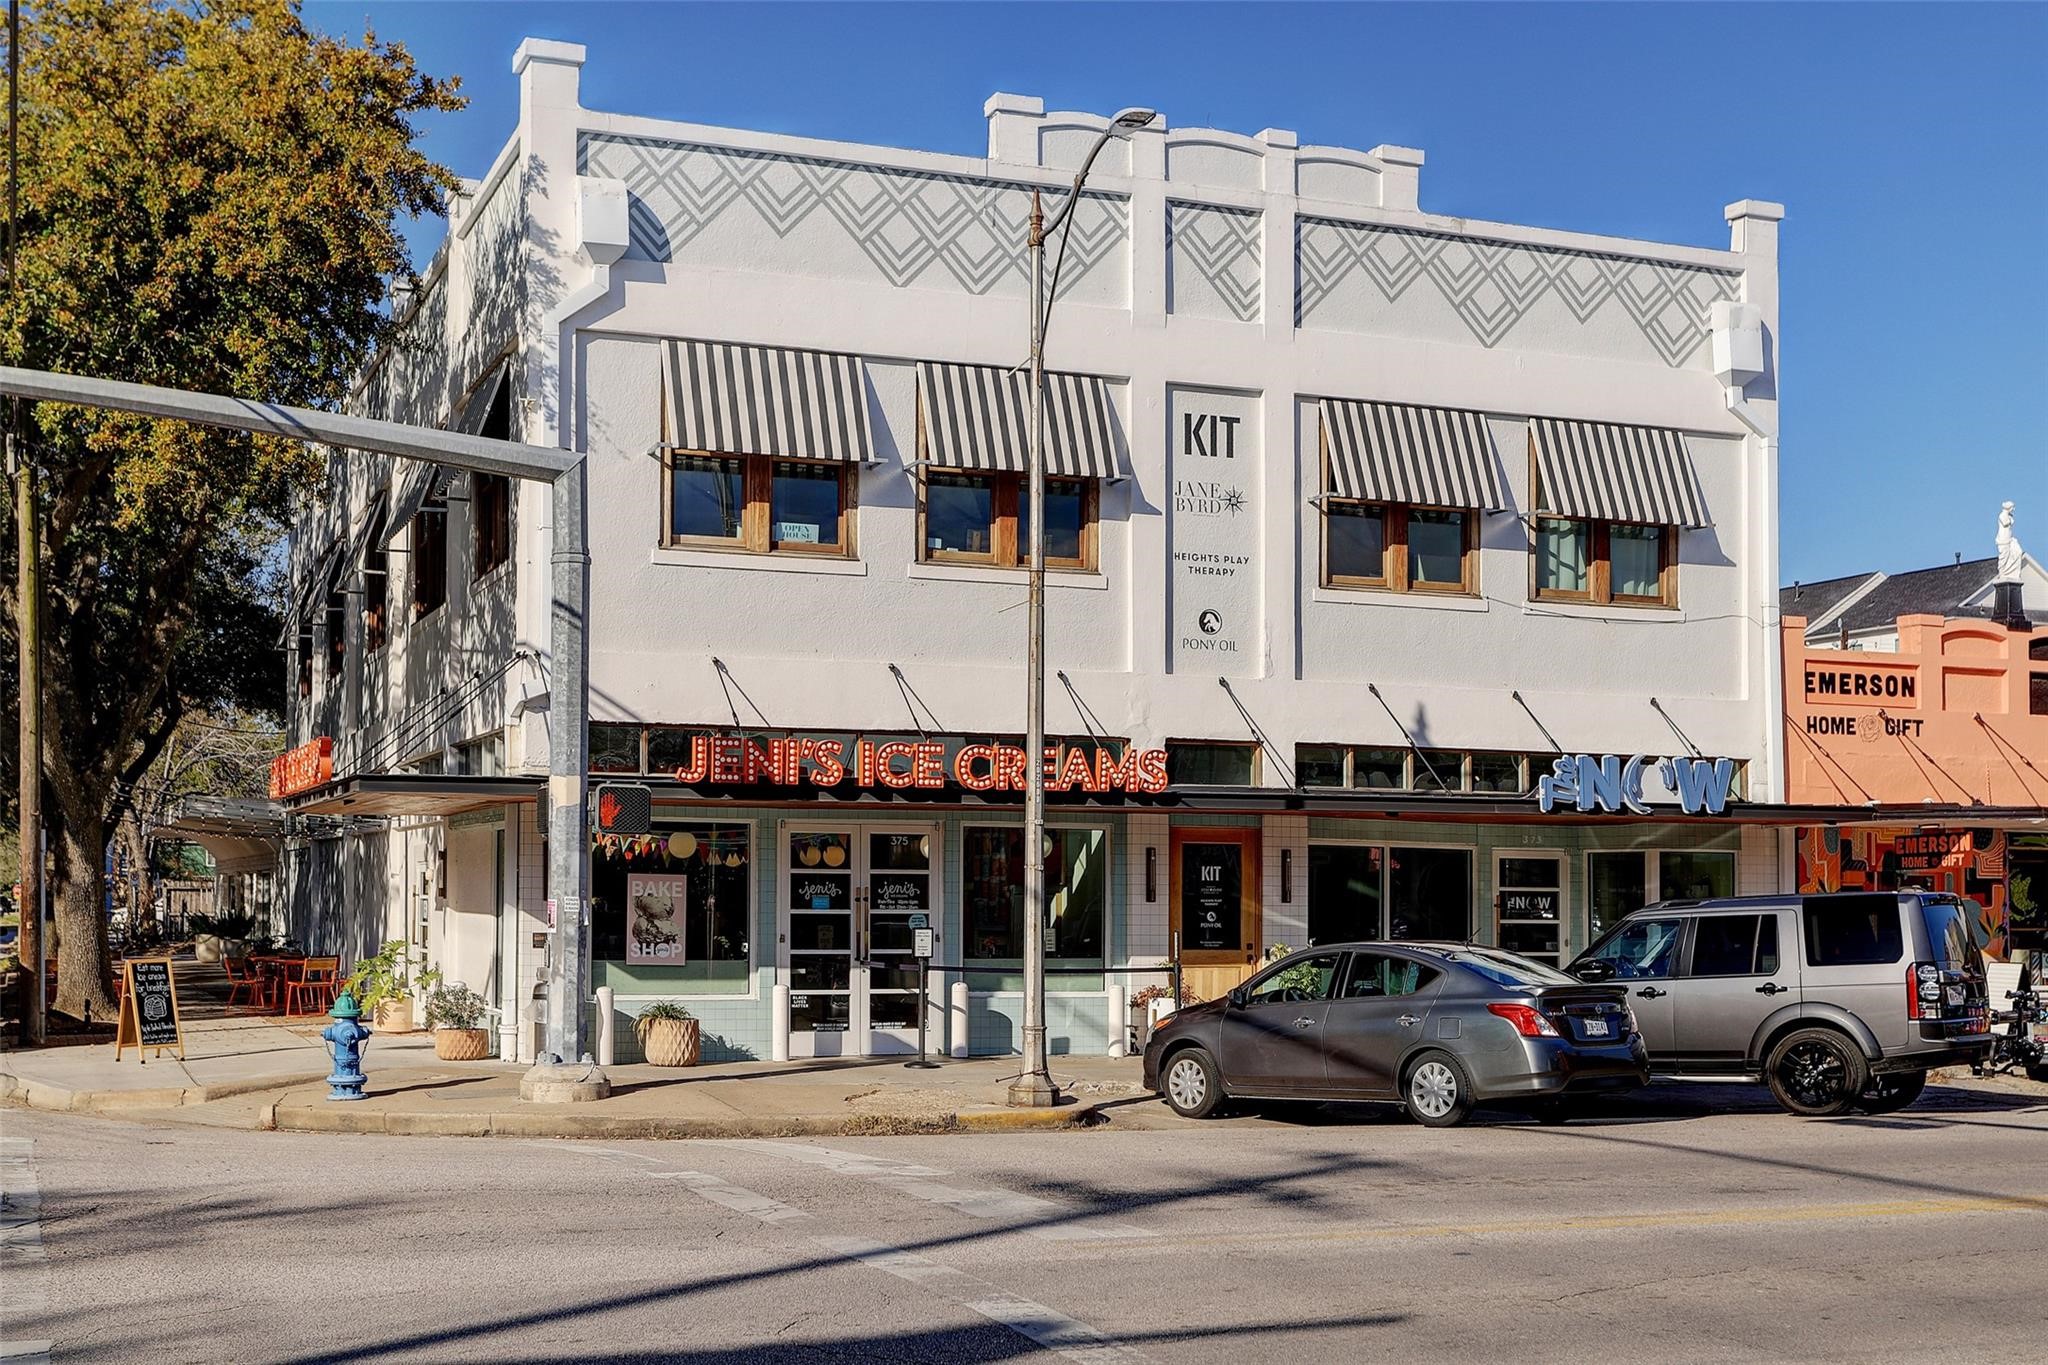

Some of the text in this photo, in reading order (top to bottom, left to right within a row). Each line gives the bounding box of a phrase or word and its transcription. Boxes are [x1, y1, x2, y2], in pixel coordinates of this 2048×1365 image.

[1184, 412, 1241, 459] KIT
[1175, 480, 1221, 499] JANE
[1176, 497, 1222, 513] BYRD
[784, 524, 810, 532] OPEN
[1174, 551, 1250, 565] HEIGHTS PLAY
[1188, 565, 1235, 577] THERAPY
[1182, 637, 1239, 652] PONY OIL
[1805, 671, 1915, 698] EMERSON
[1806, 715, 1924, 737] HOME GIFT
[675, 735, 844, 785] JENI'S
[857, 740, 945, 789] ICE
[954, 744, 1169, 794] CREAMS
[890, 836, 909, 846] 375
[1896, 832, 1971, 854] EMERSON
[1901, 853, 1964, 868] HOME GIFT
[1201, 865, 1222, 881] KIT
[632, 880, 683, 897] BAKE
[799, 881, 842, 900] jeni's
[878, 881, 920, 900] jeni's
[630, 942, 683, 959] SHOP
[137, 964, 164, 972] Eat more
